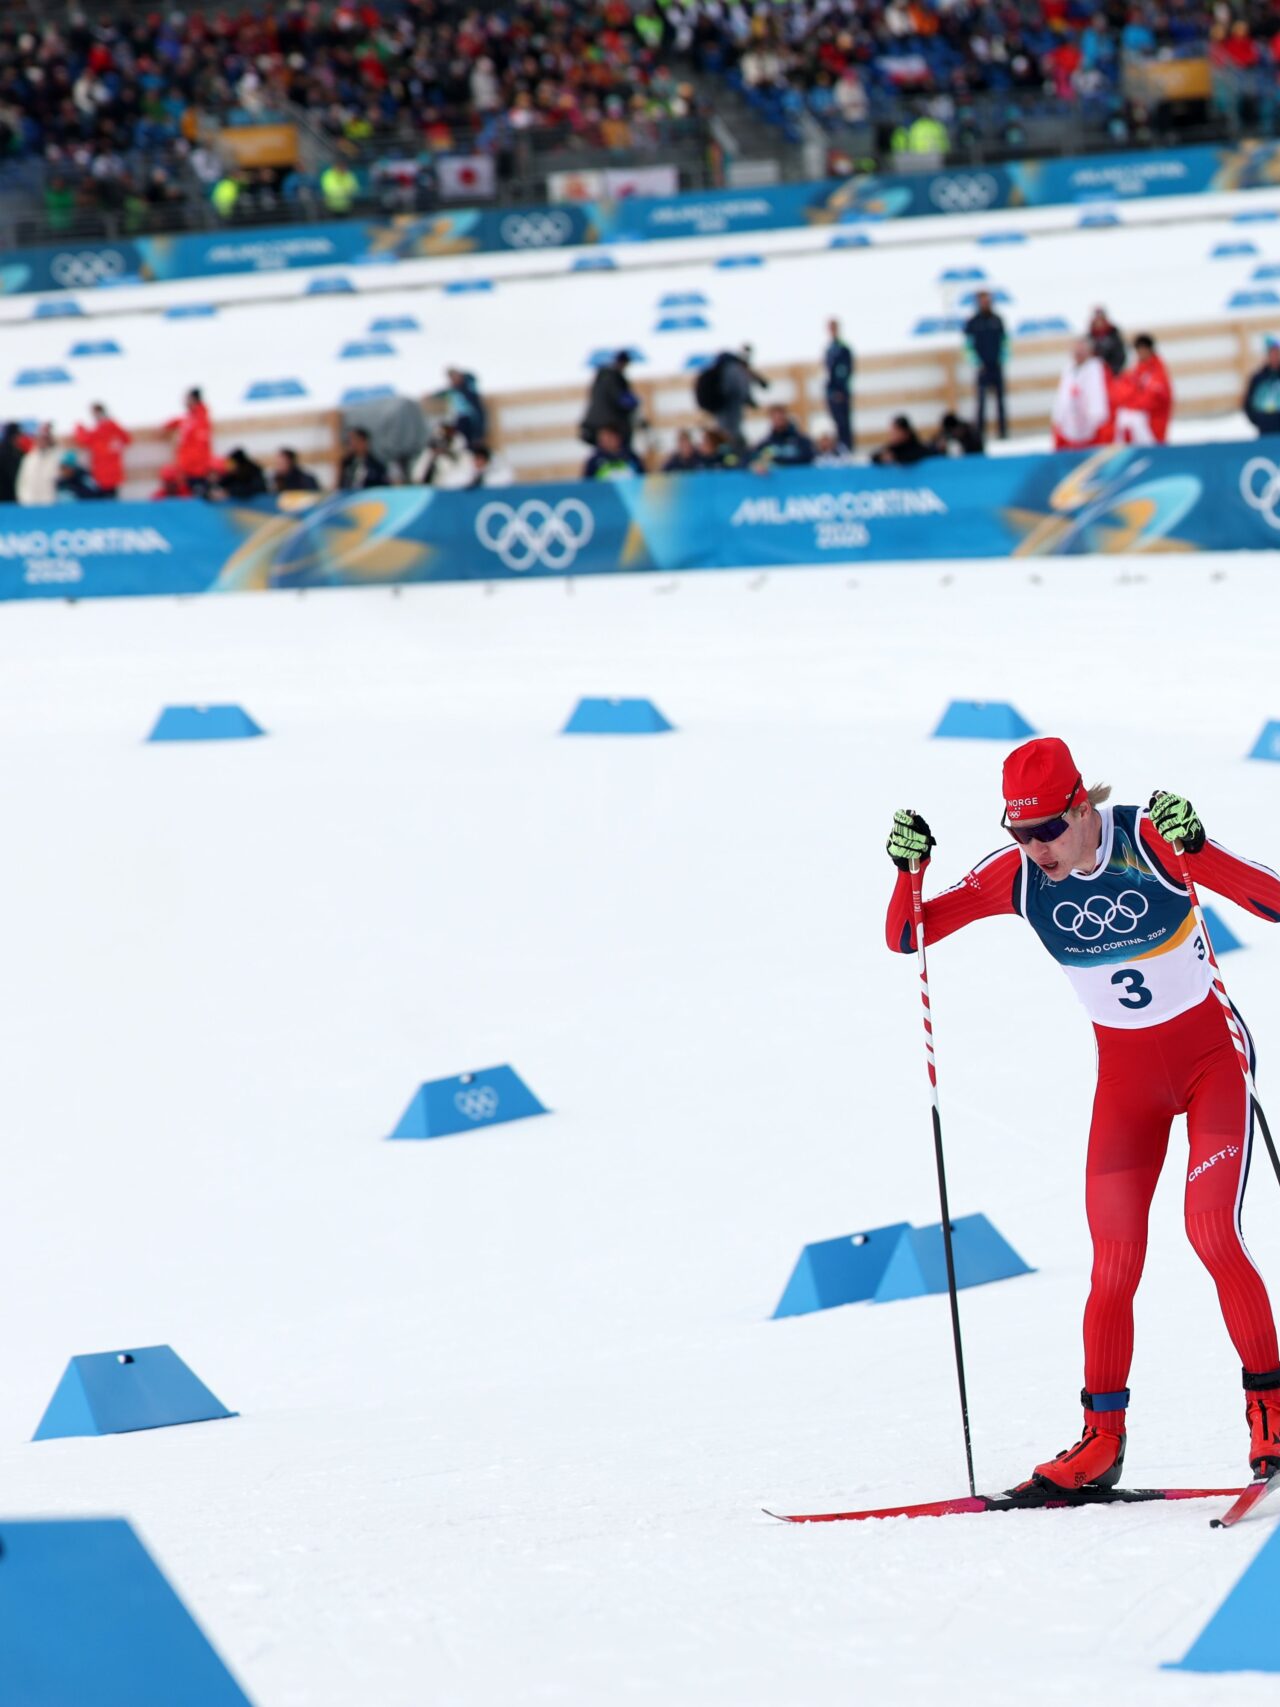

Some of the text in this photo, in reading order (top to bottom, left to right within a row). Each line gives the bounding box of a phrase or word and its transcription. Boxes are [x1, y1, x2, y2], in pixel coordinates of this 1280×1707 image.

[1008, 797, 1039, 807] NORGE
[1103, 937, 1146, 951] CORTINA
[1147, 927, 1167, 941] 2026
[1193, 935, 1206, 961] 3
[1111, 968, 1153, 1009] 3
[1188, 1149, 1227, 1182] CRAFT
